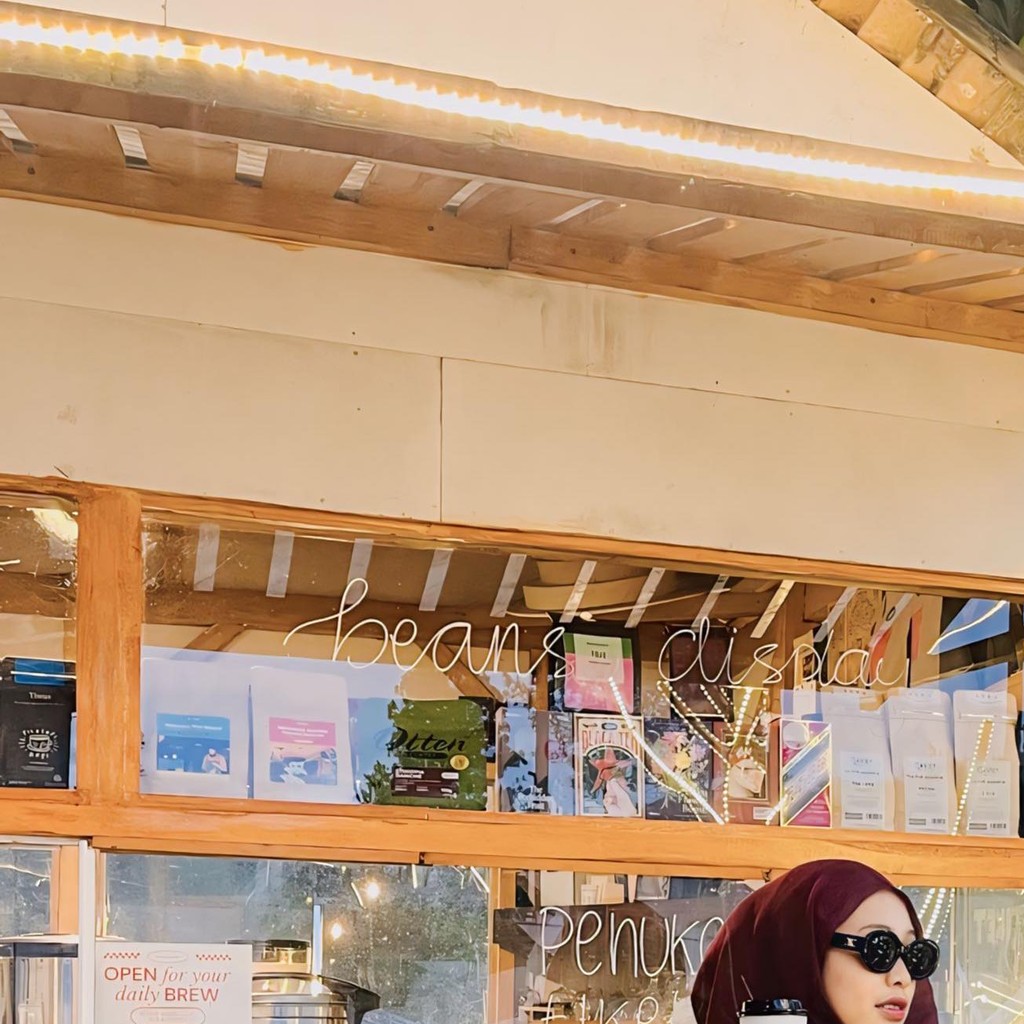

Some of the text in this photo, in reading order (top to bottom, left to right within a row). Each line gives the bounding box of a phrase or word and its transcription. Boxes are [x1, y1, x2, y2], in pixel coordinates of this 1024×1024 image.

[283, 577, 576, 679] beans
[104, 966, 232, 987] OPEN for your
[115, 985, 219, 1006] daily BREW
